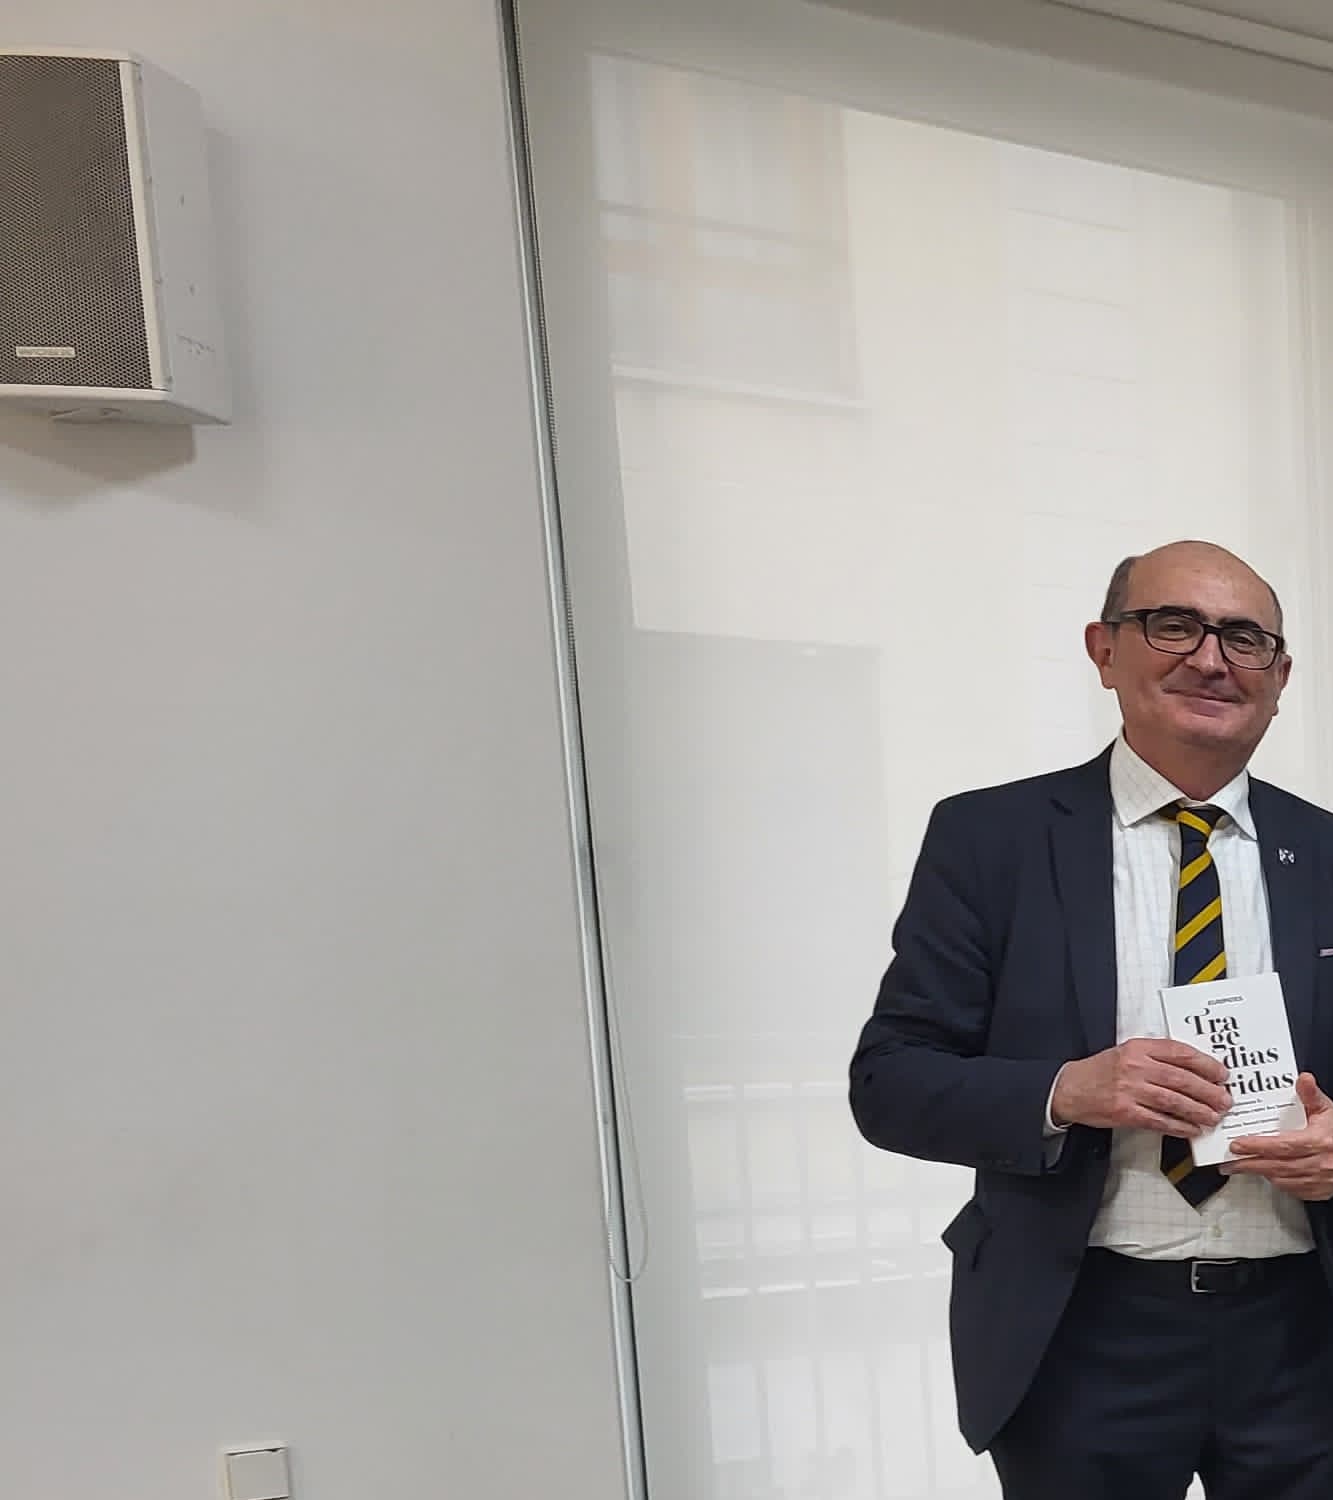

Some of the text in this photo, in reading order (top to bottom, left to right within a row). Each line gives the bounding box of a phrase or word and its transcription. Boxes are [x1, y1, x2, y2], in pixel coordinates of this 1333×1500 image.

[1184, 1008, 1240, 1035] Tra
[1223, 1045, 1279, 1070] dias
[1224, 1071, 1294, 1096] ridas
